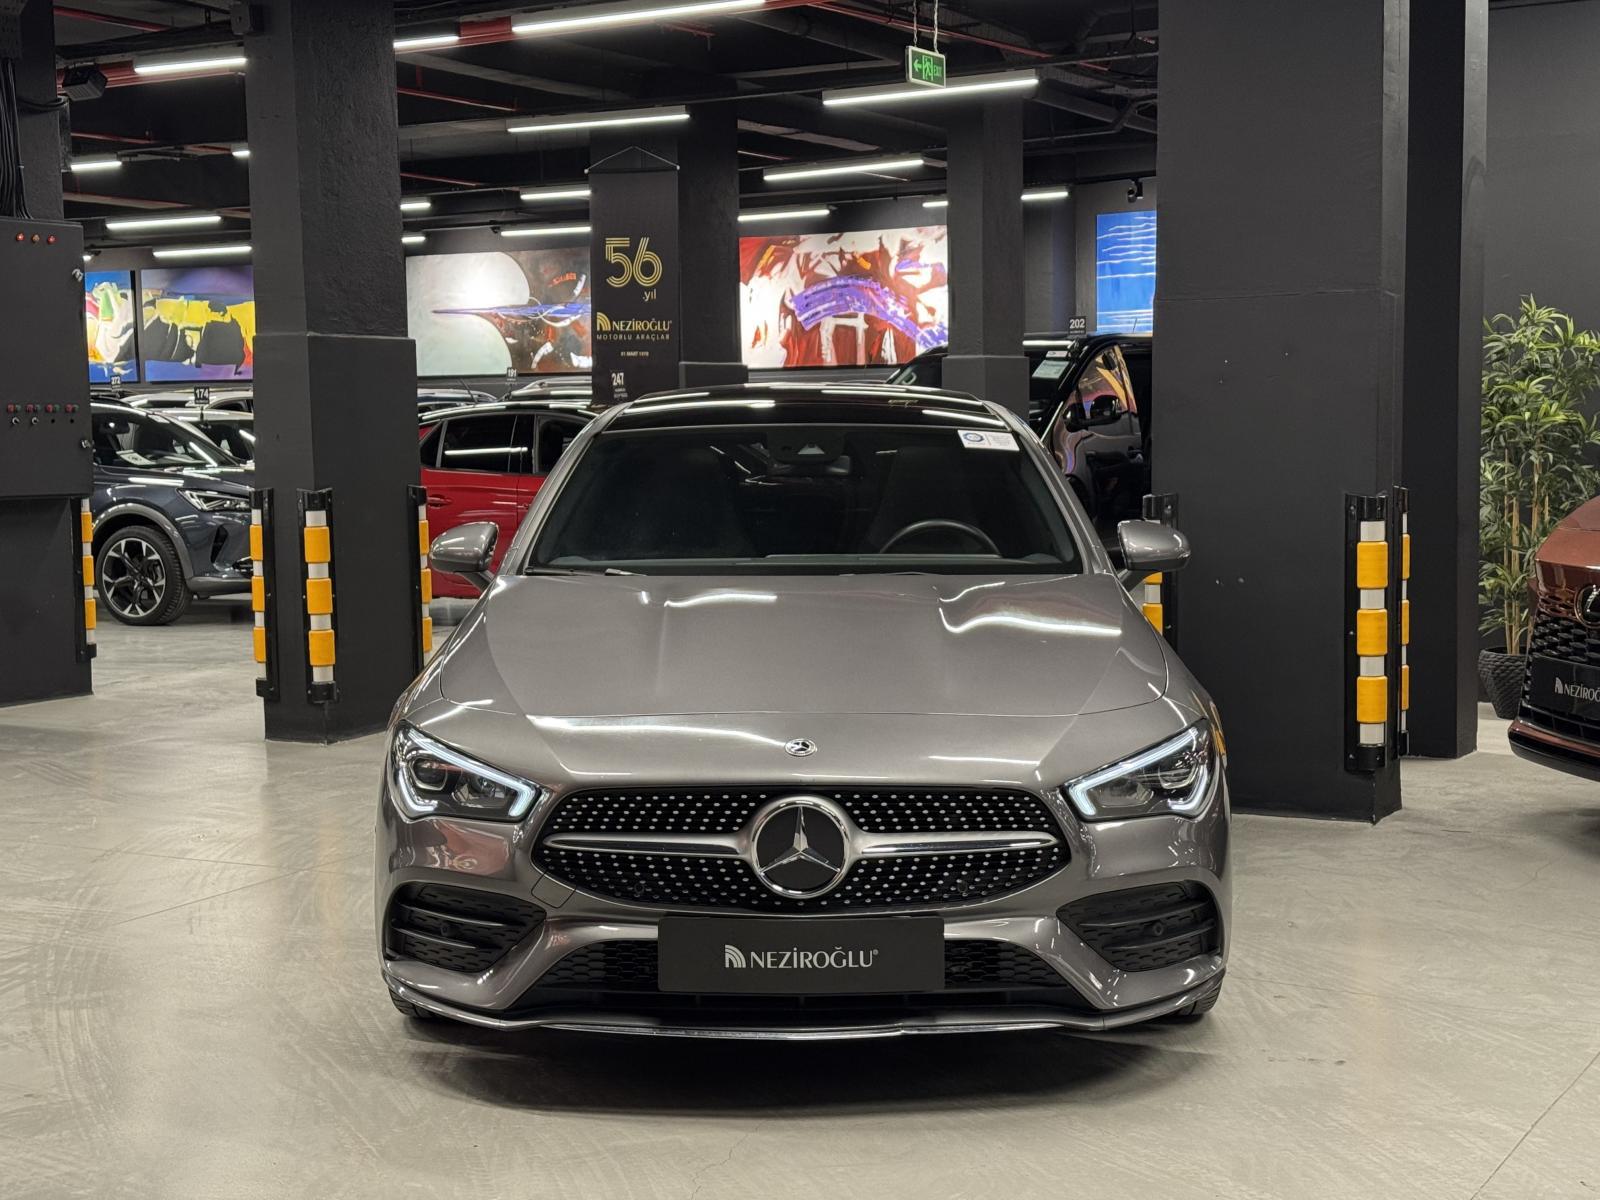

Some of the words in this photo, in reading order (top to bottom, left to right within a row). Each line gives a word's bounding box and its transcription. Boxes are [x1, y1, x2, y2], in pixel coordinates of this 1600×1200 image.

[605, 237, 662, 287] 56
[1069, 318, 1085, 328] 202
[635, 334, 670, 342] ARAÇLAR
[611, 372, 625, 386] 247
[195, 388, 209, 398] 174
